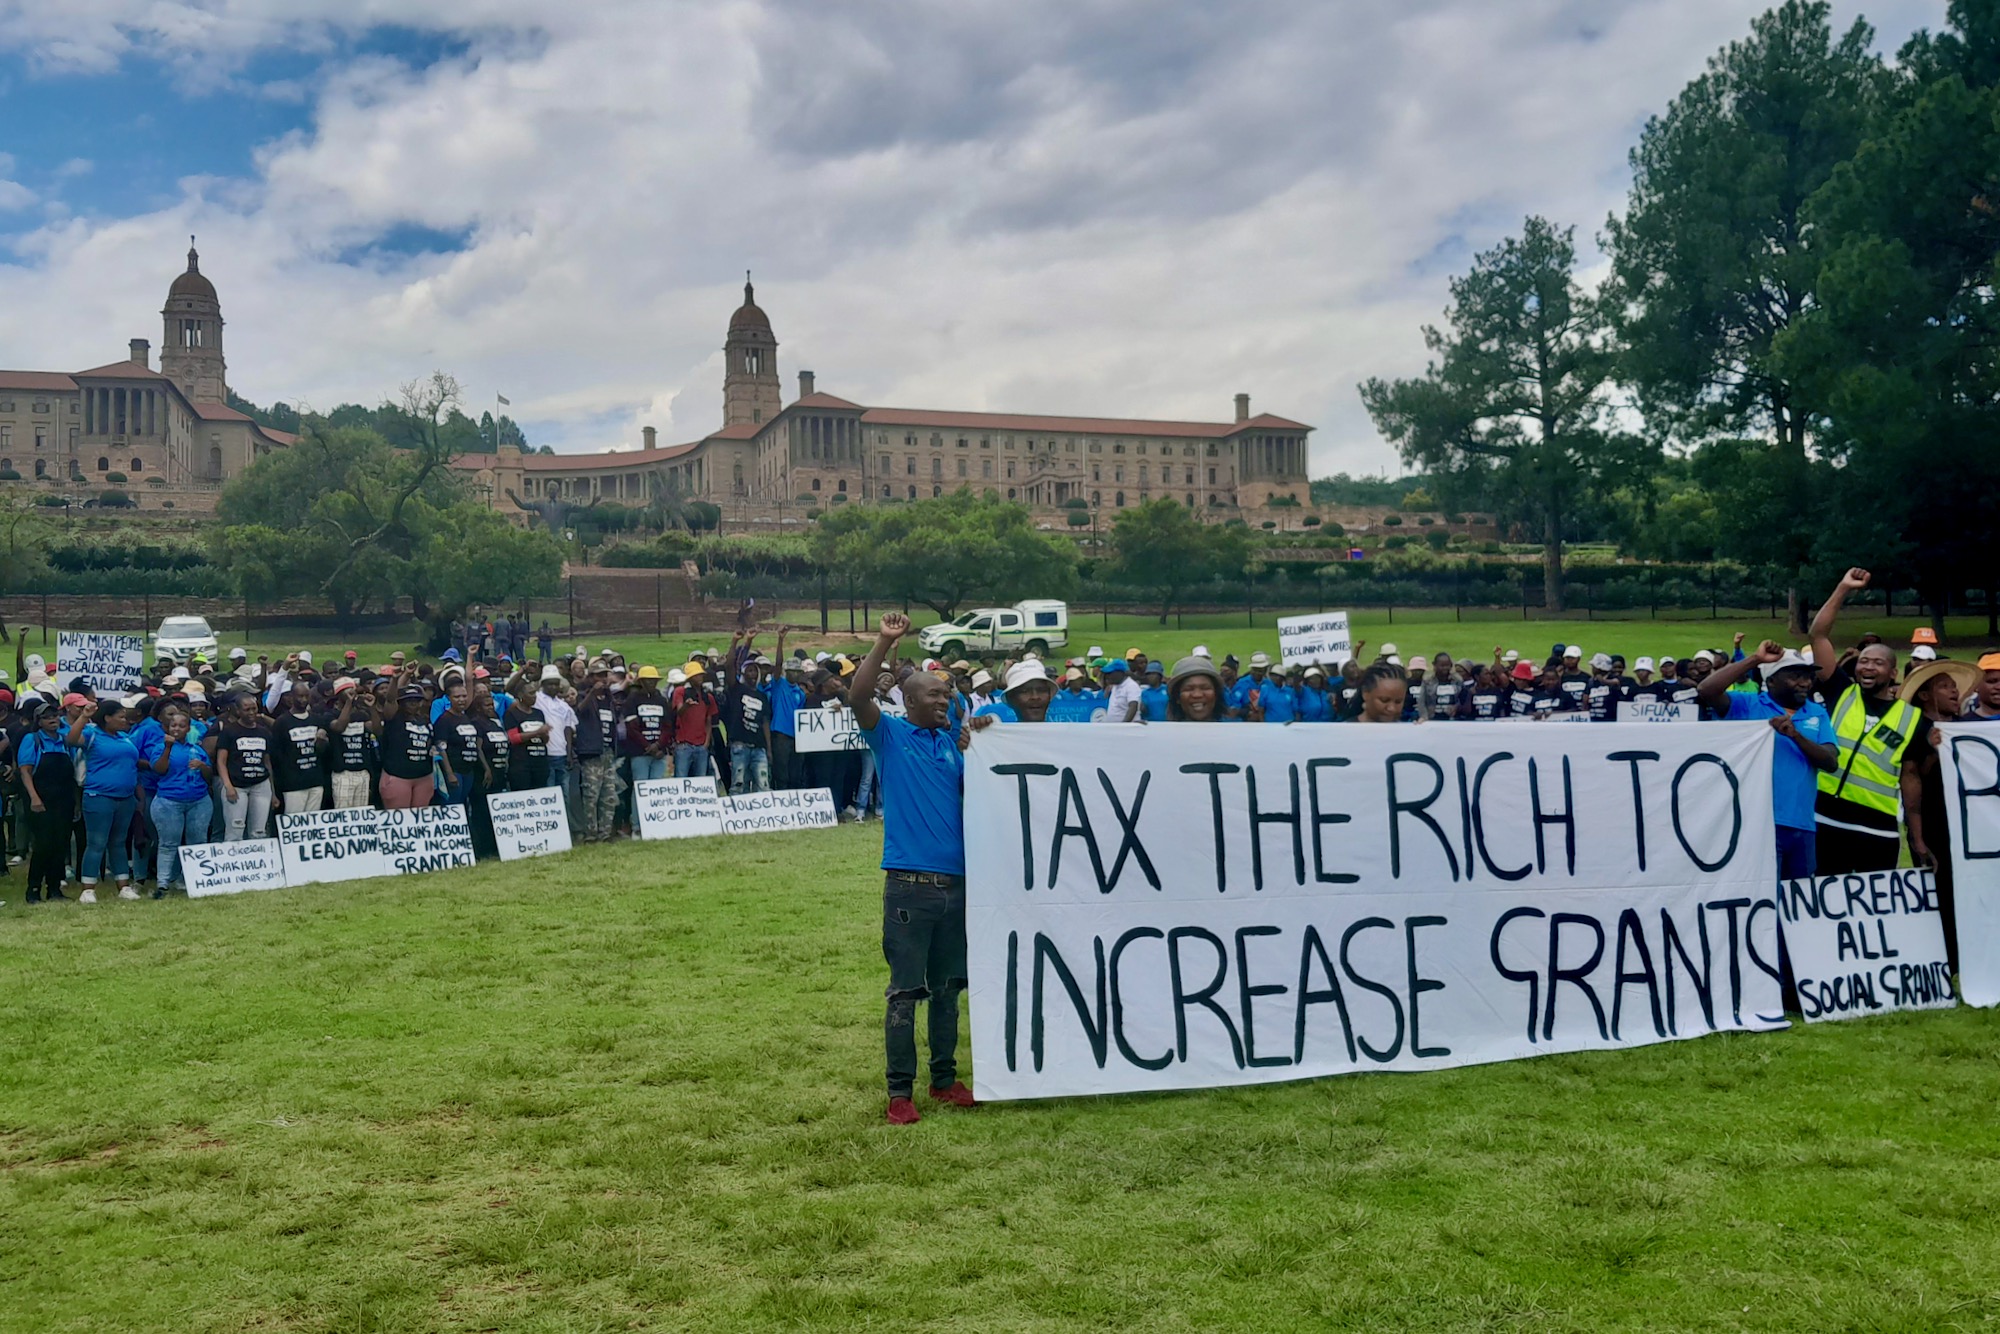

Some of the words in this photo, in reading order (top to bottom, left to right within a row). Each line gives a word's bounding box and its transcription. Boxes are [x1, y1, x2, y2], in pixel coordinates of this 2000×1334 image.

[60, 632, 84, 647] WHY
[88, 634, 113, 648] MUST
[75, 648, 125, 663] STARVE
[58, 659, 106, 674] BECAUSE
[107, 663, 122, 675] OF
[798, 711, 824, 732] FIX
[828, 710, 858, 731] THE
[637, 782, 678, 797] Empty
[491, 798, 525, 811] Cooking
[540, 793, 556, 805] and
[722, 789, 801, 814] Household
[321, 811, 347, 824] COME
[348, 810, 359, 821] TO
[361, 809, 376, 820] US
[379, 809, 404, 826] 20
[409, 805, 461, 824] YEARS
[644, 810, 666, 822] we
[668, 809, 692, 820] are
[990, 763, 1161, 894] TAX
[1180, 757, 1361, 893] THE
[1386, 751, 1576, 883] RICH
[1606, 751, 1742, 873] TO
[282, 828, 326, 844] BEFORE
[379, 825, 431, 841] TALKING
[434, 824, 469, 838] ABOUT
[535, 821, 558, 833] R350
[299, 841, 345, 862] LEAD
[347, 837, 381, 855] NOW!
[381, 841, 416, 855] BASIC
[425, 838, 473, 851] INCOME
[394, 853, 450, 875] GRANT
[451, 852, 472, 867] ACT
[1778, 869, 1940, 923] INCREASE
[1837, 918, 1899, 962] ALL
[1005, 916, 1451, 1073] INCREASE
[1490, 897, 1787, 1044] GRANTS
[1797, 971, 1883, 1018] SOCIAL
[1879, 961, 1956, 1007] GRANTS
